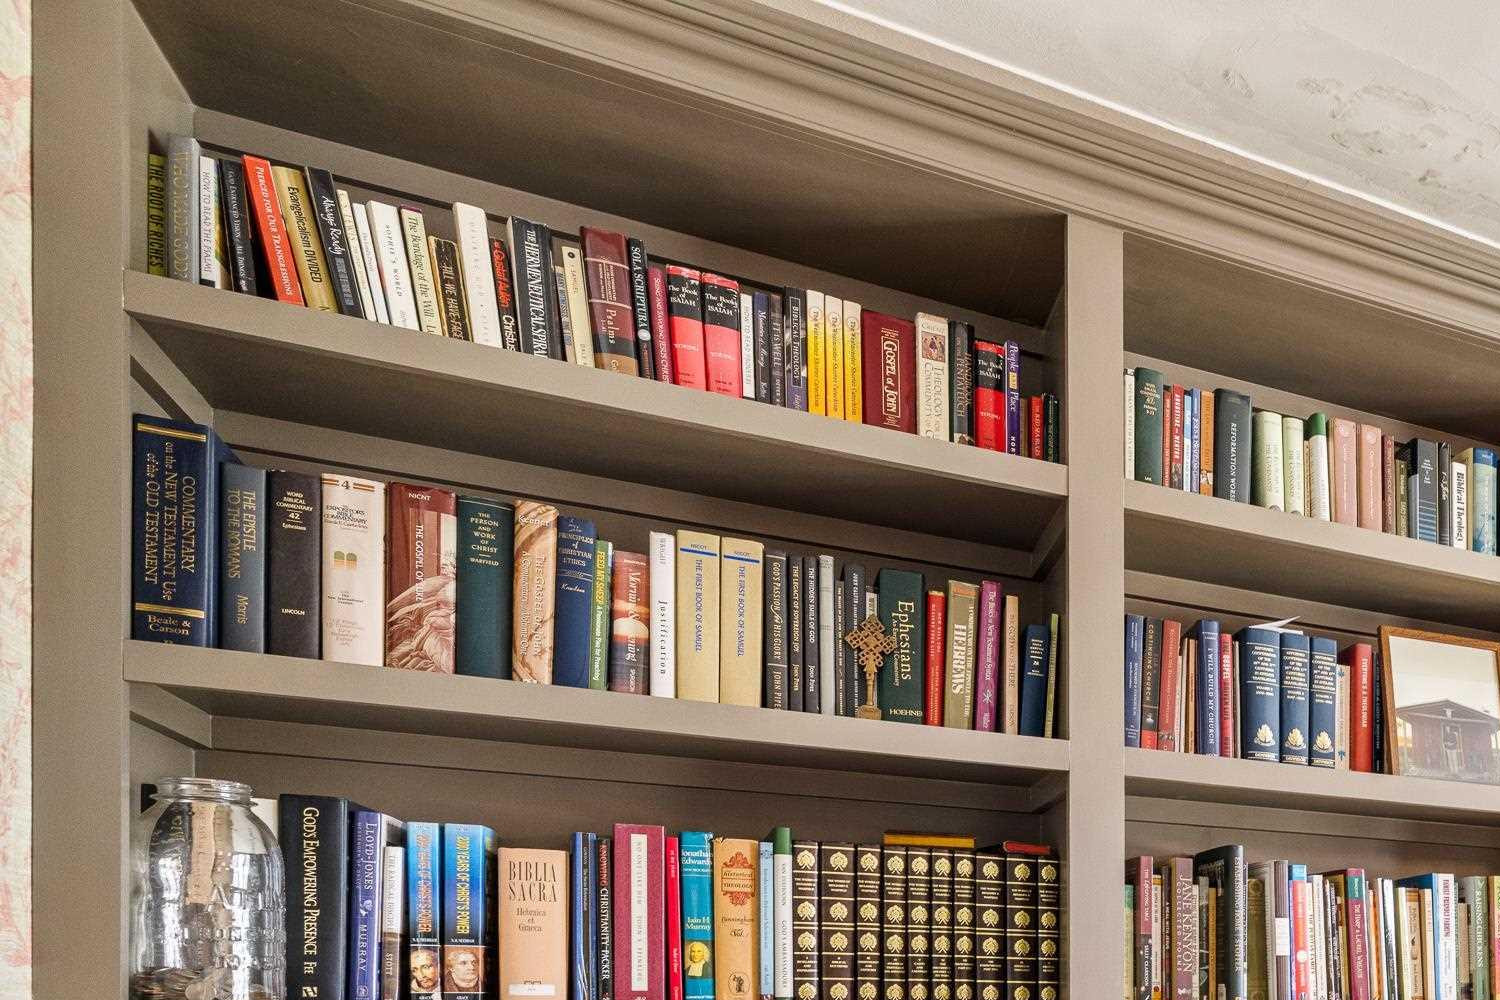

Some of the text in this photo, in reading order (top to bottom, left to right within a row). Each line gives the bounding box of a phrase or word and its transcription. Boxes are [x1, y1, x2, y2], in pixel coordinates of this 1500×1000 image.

[150, 164, 166, 268] THE ROOT OF RICHES
[256, 167, 293, 296] PIERCED TRANSGRESSIONS
[287, 187, 323, 284] Evangelicalism DIVIDED
[525, 241, 547, 328] HERMENEUTICAL
[632, 246, 649, 329] SOLA SCRIPTURA
[670, 296, 698, 307] ISAIAH
[707, 305, 734, 317] ISAIAH
[605, 309, 620, 345] Psalms
[792, 306, 802, 381] BIBLICAL THEOLOGY
[882, 339, 898, 376] GOSPEL
[1008, 344, 1020, 371] People
[884, 388, 898, 414] JOHN
[1009, 391, 1020, 413] Place
[1230, 422, 1238, 477] REFORMATION
[163, 471, 178, 502] NEW
[339, 480, 350, 490] 4
[408, 492, 431, 501] NICNT
[180, 475, 197, 574] COMMENTARY
[242, 490, 257, 552] THE EPISTLE
[288, 512, 301, 520] 42
[470, 518, 499, 527] PERSON
[144, 481, 161, 585] OLD TESTAMENT
[162, 505, 177, 578] TESTAMENT
[227, 488, 241, 579] TO THE ROMANS
[414, 524, 425, 571] THE GOSPEL
[471, 545, 498, 553] CHRIST
[473, 531, 497, 540] WORK
[808, 568, 816, 579] THE
[161, 581, 177, 601] Use
[695, 559, 704, 653] THE FIRST BOOK OF SAMUEL
[772, 583, 782, 611] PASSION
[808, 580, 816, 603] HIDDEN
[147, 615, 192, 628] Beale &
[236, 594, 250, 626] Morris
[281, 608, 306, 616] LINCOLN
[737, 566, 746, 658] THE FIRST BOOK OF SAMUEL
[809, 622, 816, 630] OF
[149, 622, 192, 636] Carson
[658, 600, 670, 675] Justification
[773, 625, 782, 638] HIS
[808, 630, 816, 644] GOD
[891, 601, 916, 680] Ephesians
[773, 639, 782, 661] GLORY
[952, 624, 968, 695] HEBREWS
[773, 671, 783, 689] JOHN
[361, 823, 378, 890] LLOYD-JONES
[508, 861, 557, 882] BIBLIA
[303, 807, 320, 976] GOD'S EMPOWERING PRESENCE FEE
[456, 850, 470, 934] YEARS POWER
[508, 882, 557, 903] SACRA
[600, 888, 609, 946] CHRISTIANITY
[1180, 874, 1194, 972] JANE KENYON
[359, 925, 368, 972] MURRAY
[602, 949, 610, 981] PACKER
